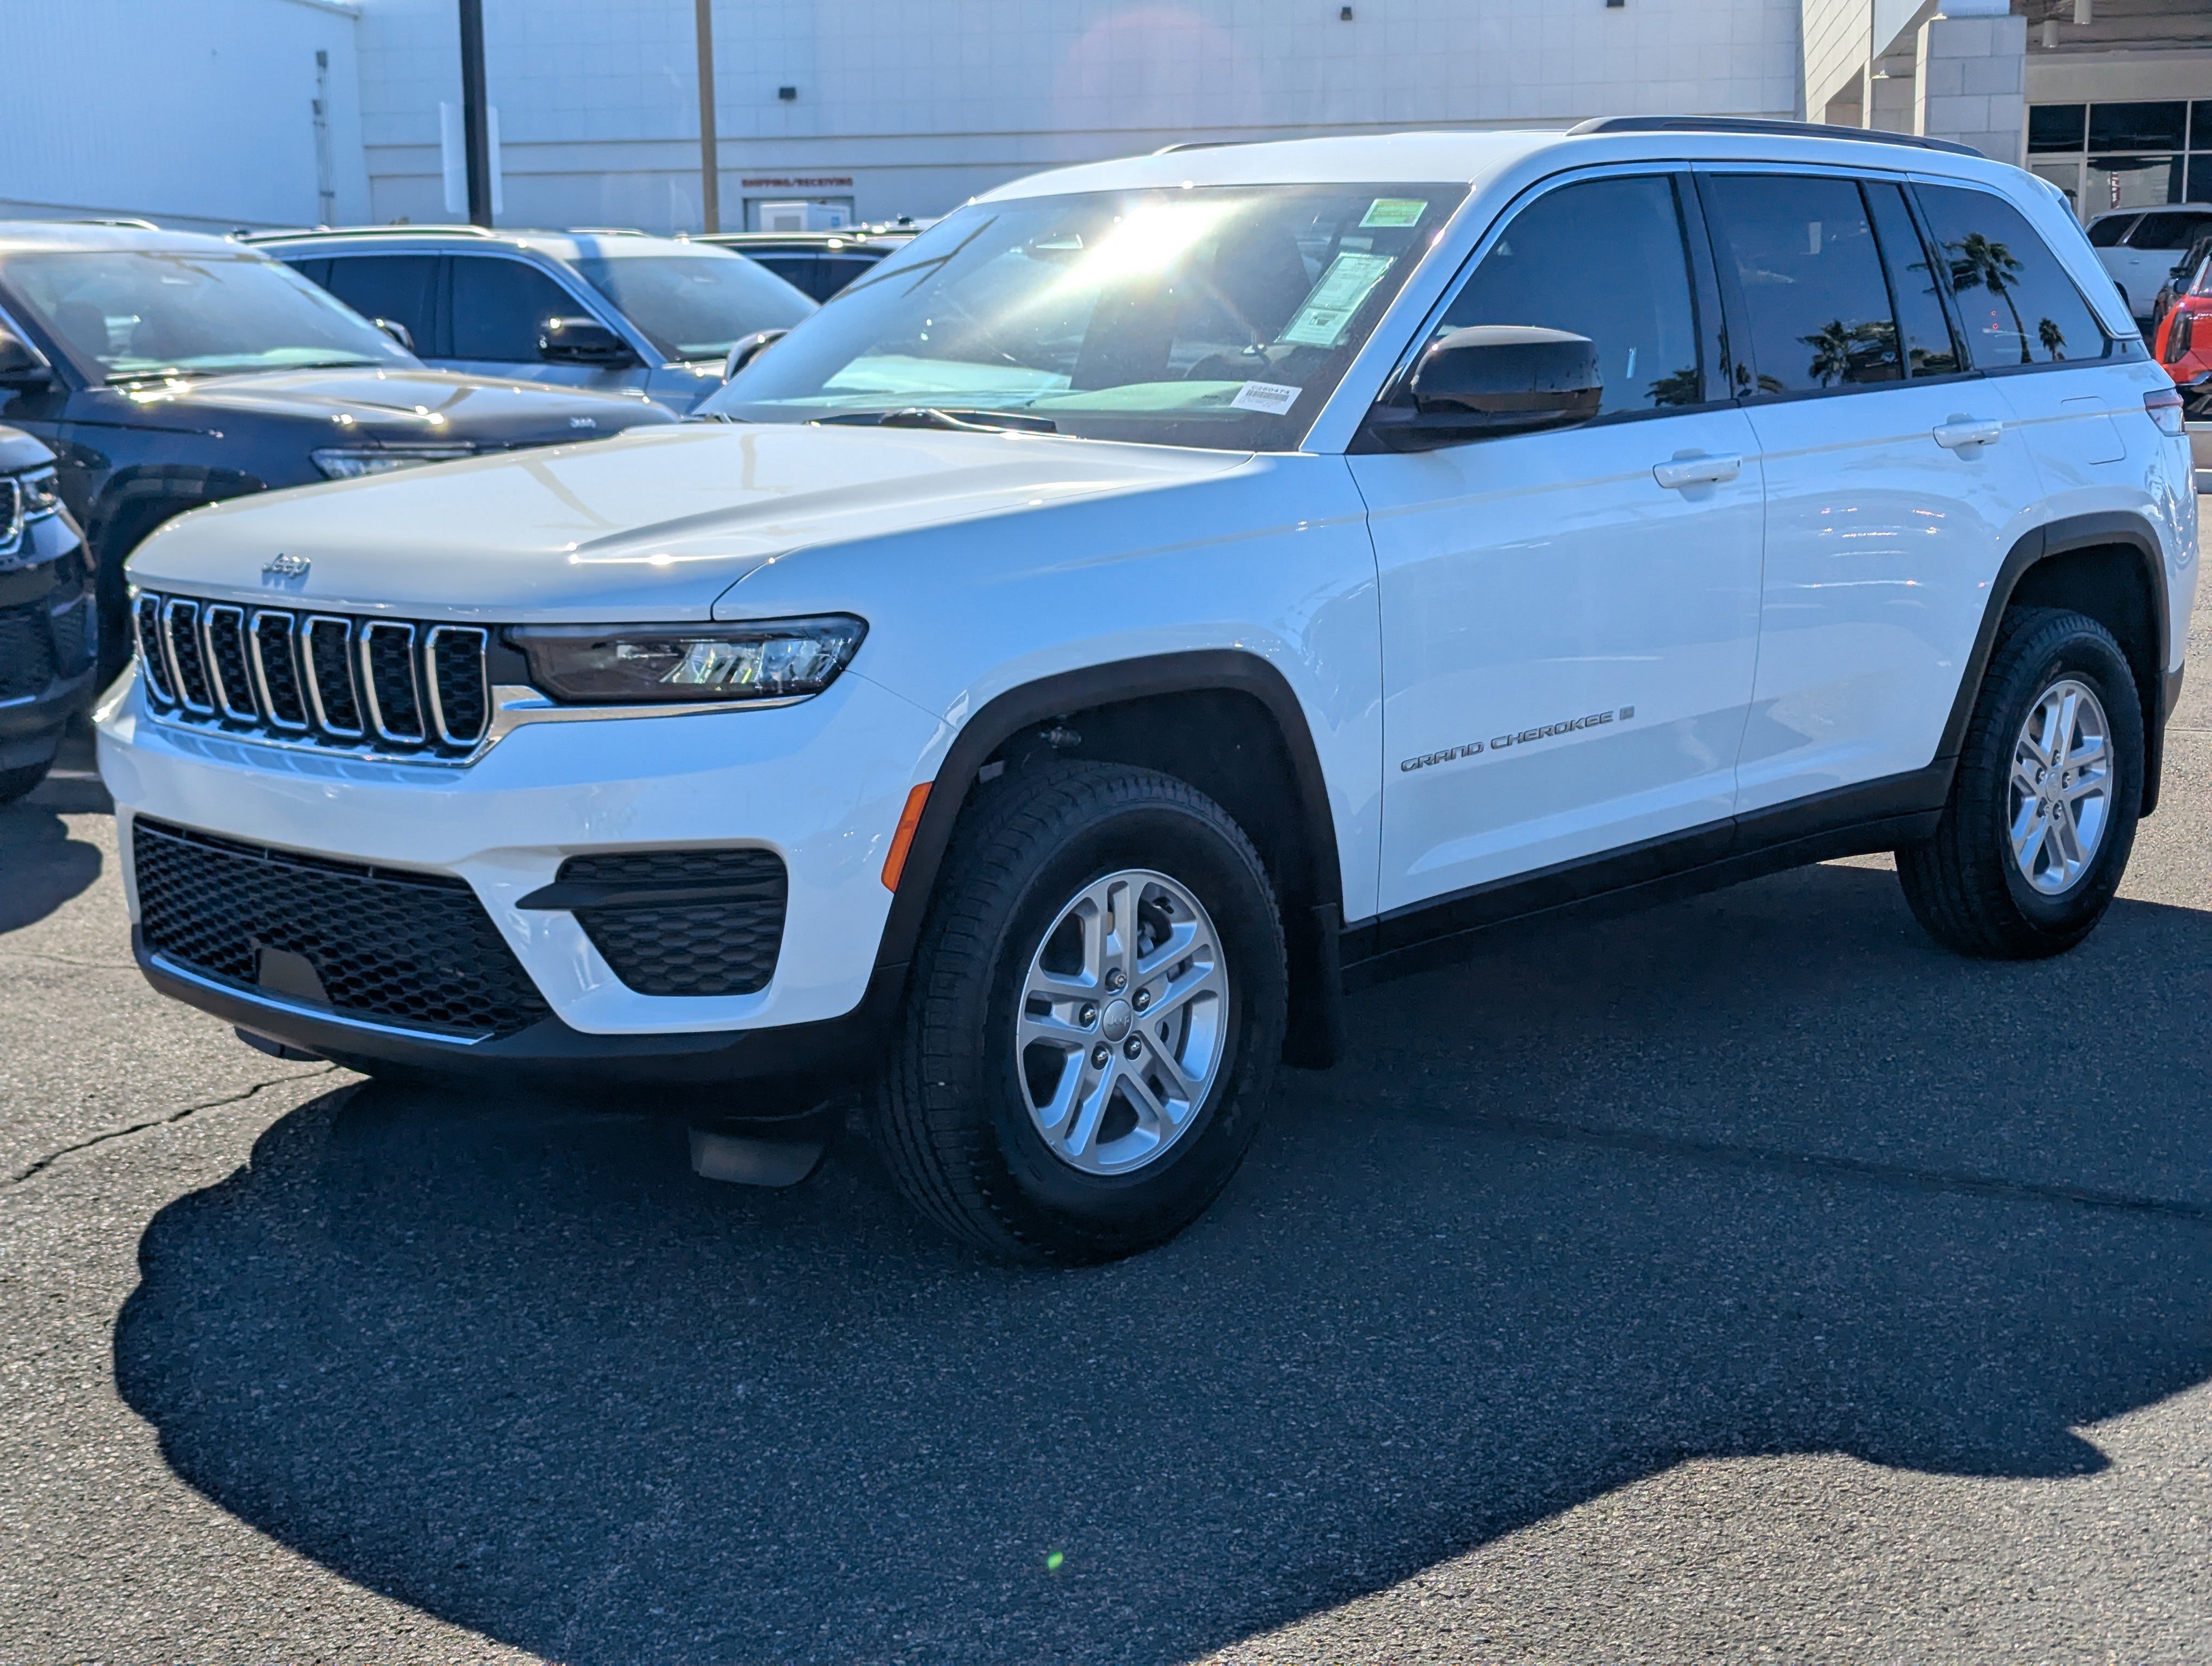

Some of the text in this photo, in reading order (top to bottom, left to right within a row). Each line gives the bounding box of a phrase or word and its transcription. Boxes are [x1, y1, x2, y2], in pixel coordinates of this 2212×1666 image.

[261, 553, 311, 579] Jeep
[1401, 710, 1613, 772] GRAND CHEROKEE
[1108, 1015, 1129, 1026] Jeep
